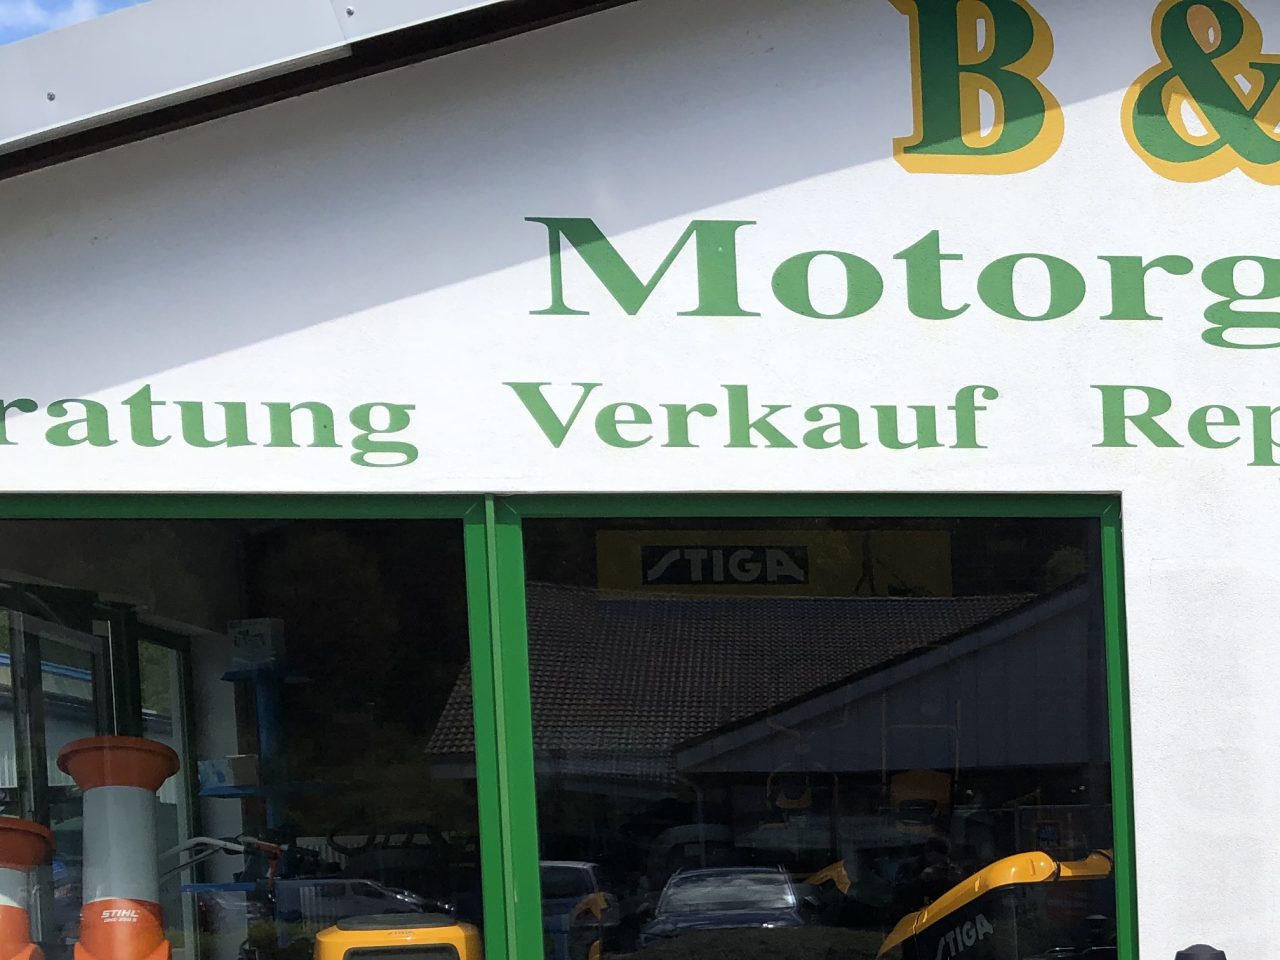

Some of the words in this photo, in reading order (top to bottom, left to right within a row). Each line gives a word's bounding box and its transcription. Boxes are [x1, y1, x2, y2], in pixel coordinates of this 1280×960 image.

[892, 0, 1065, 175] B
[502, 382, 998, 450] Verkauf
[645, 549, 806, 581] STIGA
[101, 909, 140, 918] STIHL
